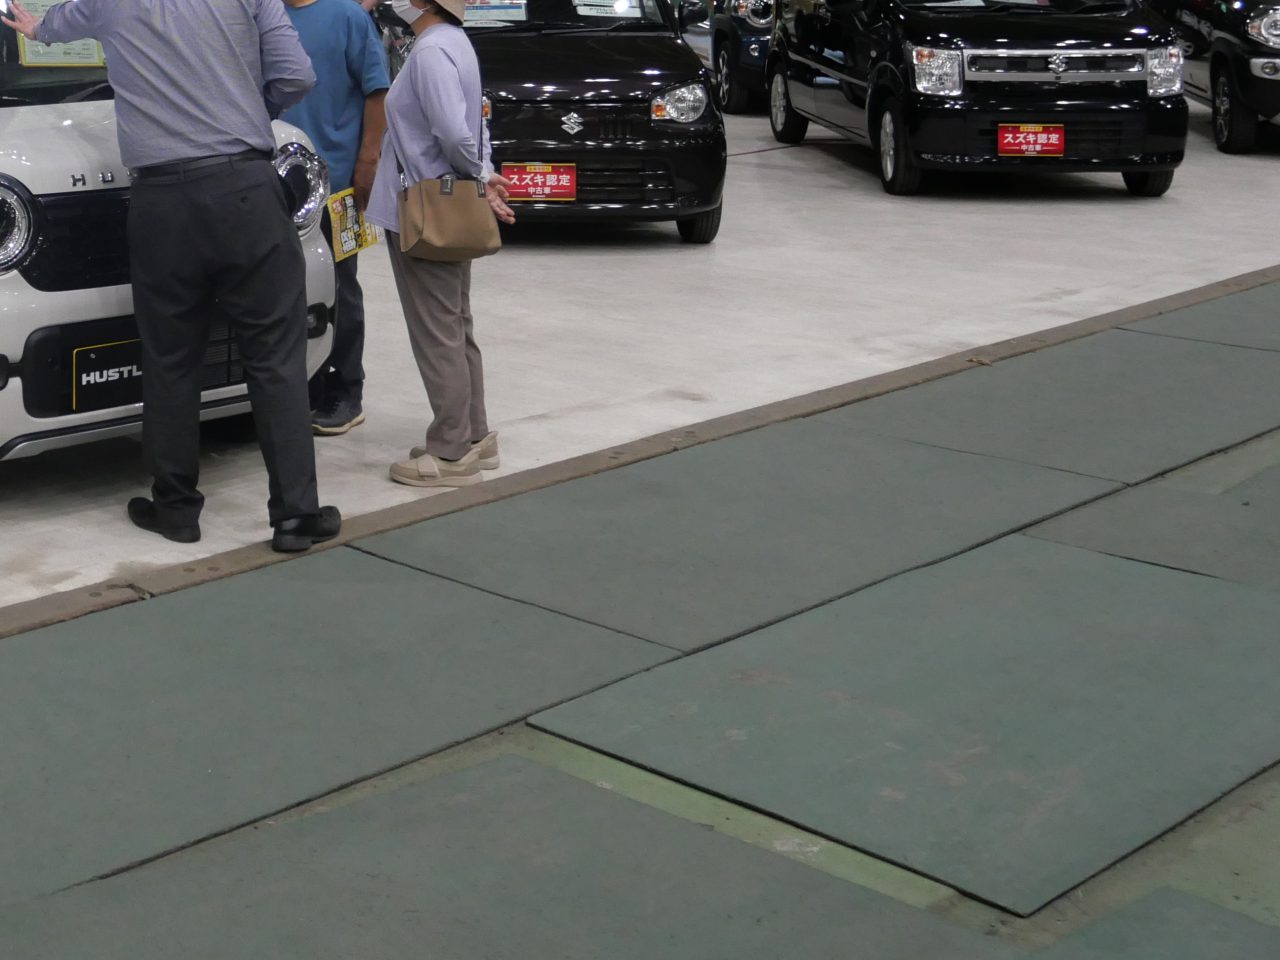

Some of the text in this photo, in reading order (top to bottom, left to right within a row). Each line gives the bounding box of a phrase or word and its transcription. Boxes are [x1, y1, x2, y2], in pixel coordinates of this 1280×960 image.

[1003, 133, 1059, 144] スズキ認定
[509, 173, 571, 186] スズキ認定
